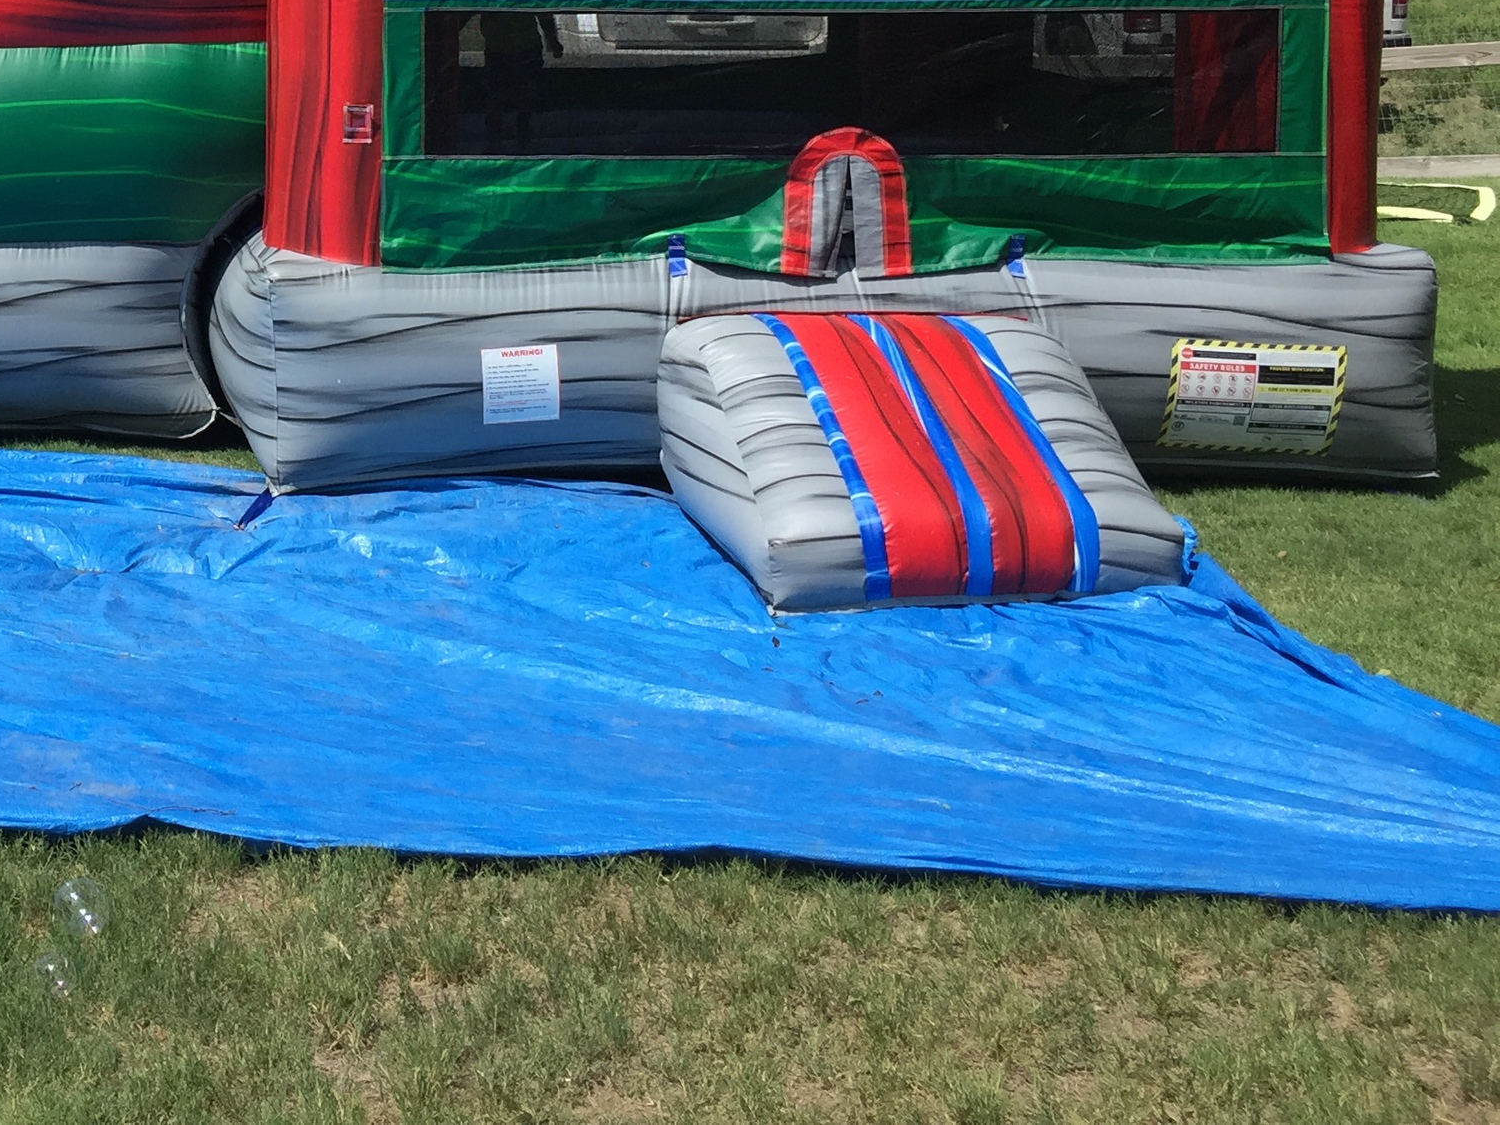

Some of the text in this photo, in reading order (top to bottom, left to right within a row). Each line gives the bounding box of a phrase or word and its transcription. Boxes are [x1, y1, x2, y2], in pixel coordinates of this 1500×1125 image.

[501, 349, 543, 358] WARNING!
[1189, 362, 1245, 372] SAFETY RULES
